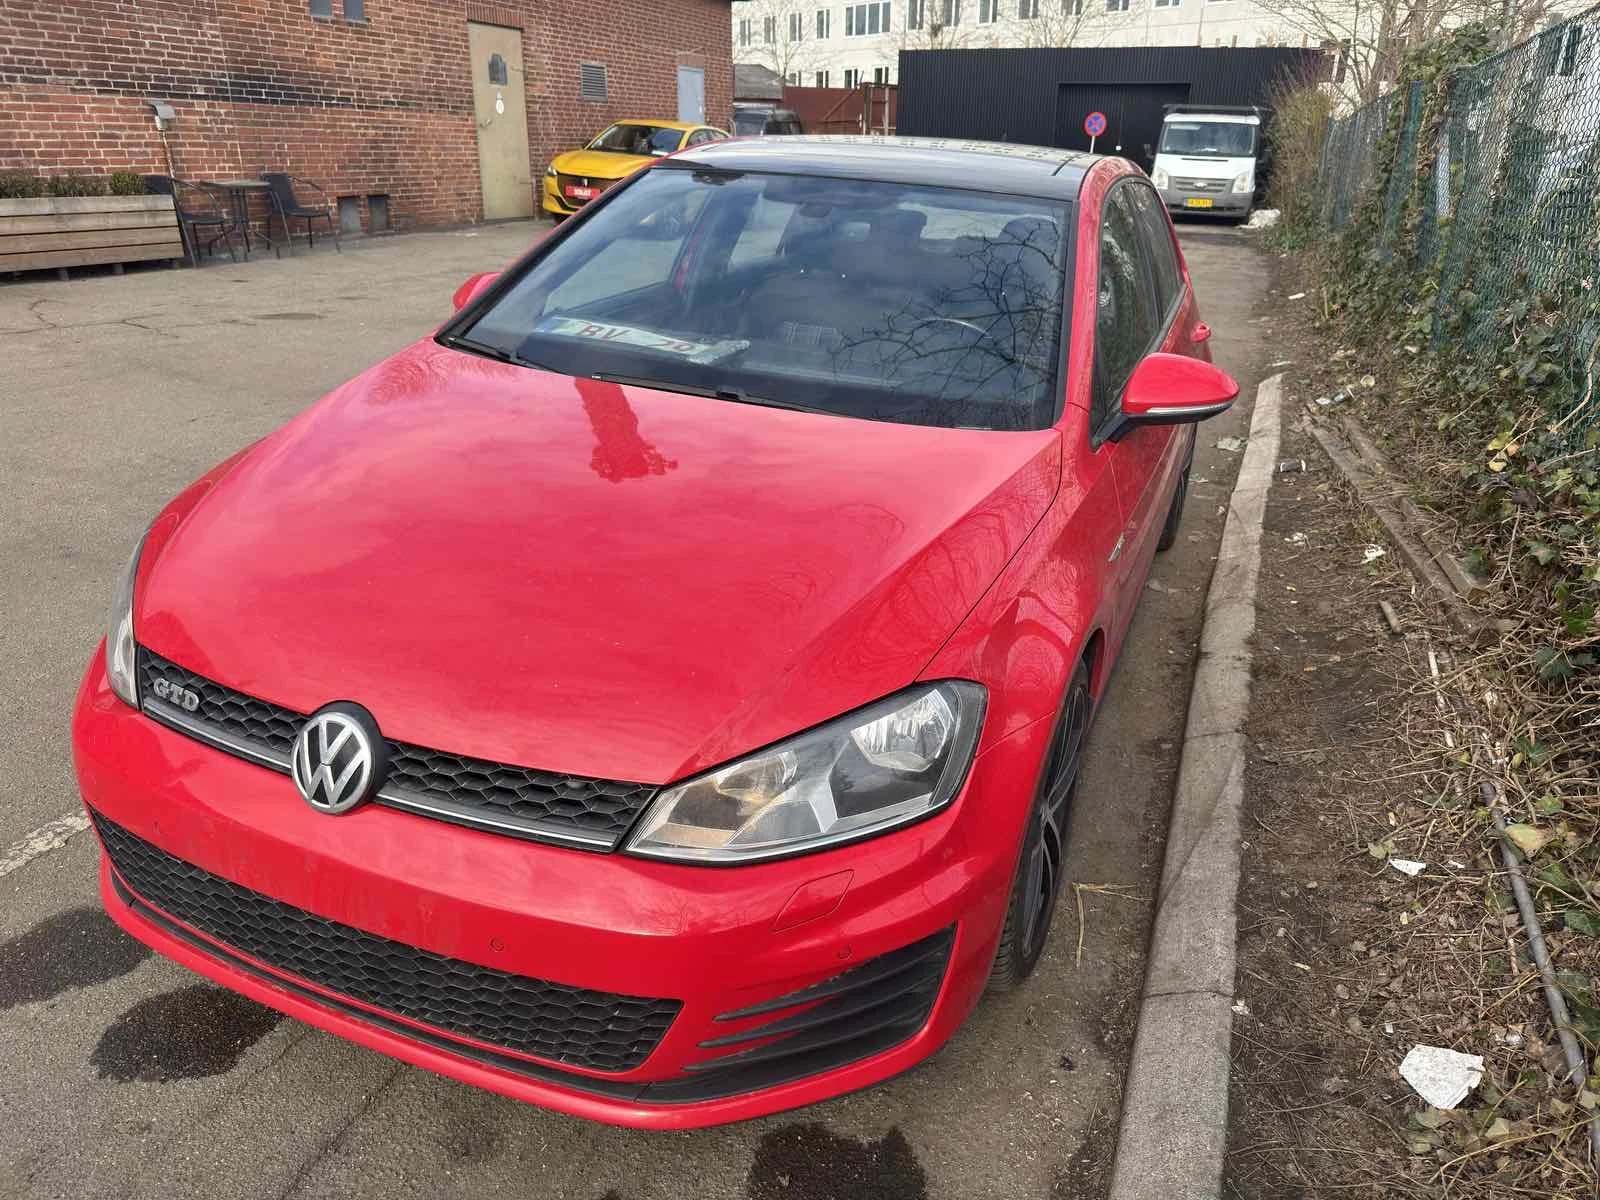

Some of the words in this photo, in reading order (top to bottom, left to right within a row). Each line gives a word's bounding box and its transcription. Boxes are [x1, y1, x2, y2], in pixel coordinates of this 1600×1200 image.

[575, 324, 629, 340] BV
[153, 678, 199, 711] GTD
[297, 714, 370, 811] VW
